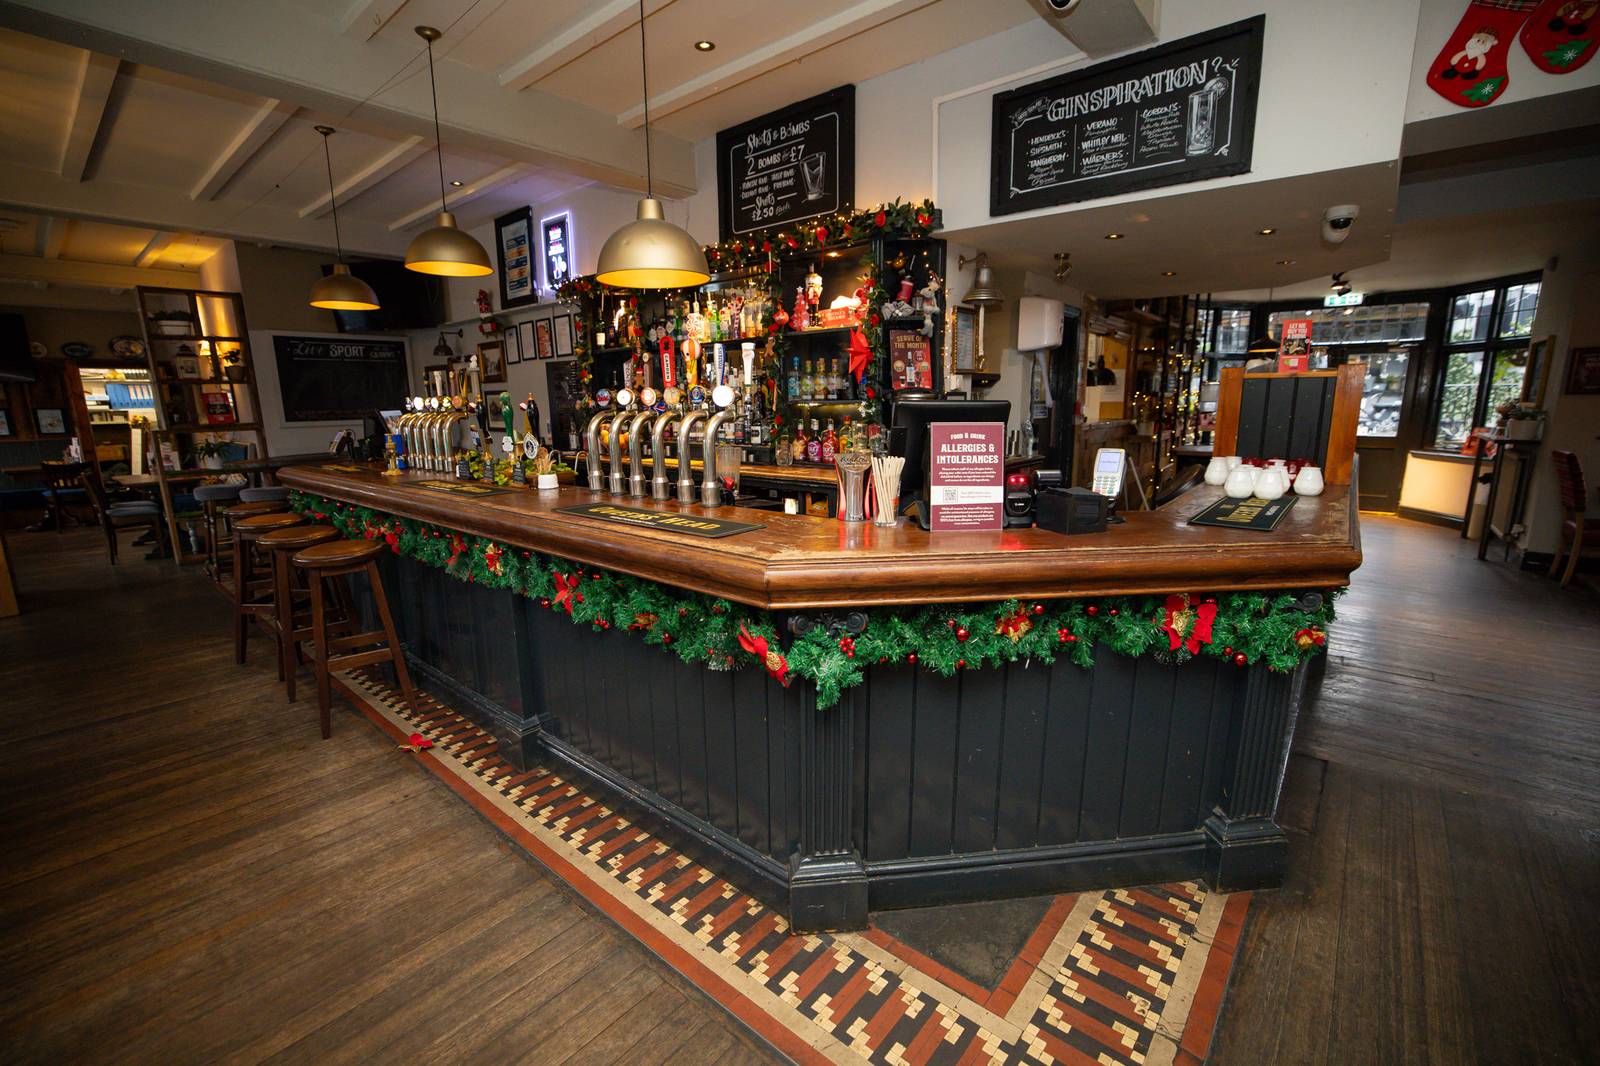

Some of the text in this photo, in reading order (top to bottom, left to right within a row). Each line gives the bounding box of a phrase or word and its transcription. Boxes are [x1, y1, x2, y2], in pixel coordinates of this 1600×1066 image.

[780, 120, 811, 140] BOMBS
[1086, 117, 1118, 131] VERANO
[1029, 141, 1063, 157] SIPSMITH
[747, 156, 756, 176] 2
[757, 152, 782, 170] BOMBS
[789, 144, 805, 162] £7
[329, 344, 366, 358] SPORT
[950, 433, 964, 441] FOOD
[941, 443, 995, 453] ALLERGIES &
[936, 454, 999, 464] INTOLERANCES
